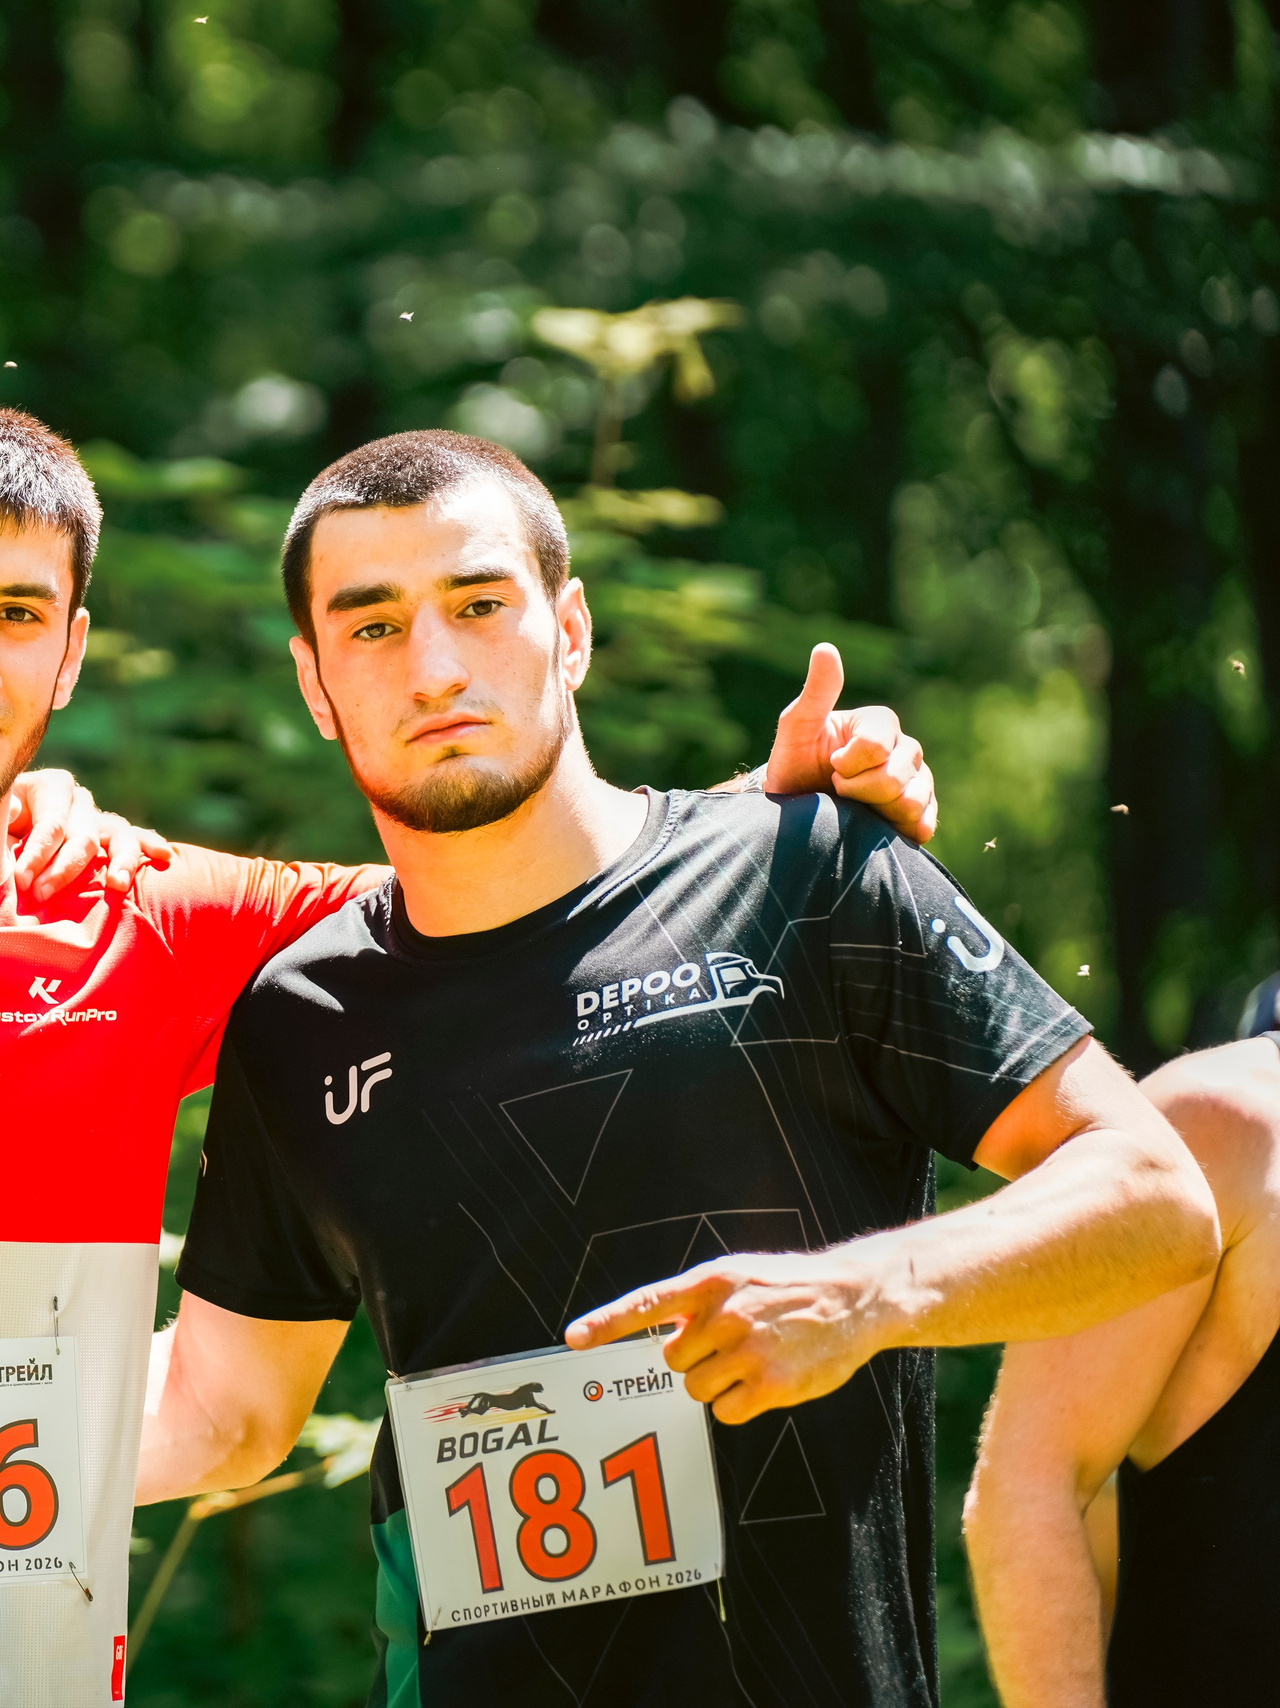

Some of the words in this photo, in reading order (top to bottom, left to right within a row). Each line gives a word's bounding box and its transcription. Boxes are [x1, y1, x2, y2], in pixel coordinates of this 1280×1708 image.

[576, 962, 701, 1017] DEPOO
[577, 988, 701, 1030] OPTIKA
[436, 1418, 559, 1464] BOGAL
[445, 1431, 677, 1595] 181
[24, 1556, 63, 1571] 2026
[451, 1592, 556, 1623] СПОРТИВНЫЙ
[562, 1576, 661, 1604] МАРАФОН
[666, 1568, 703, 1586] 2026
